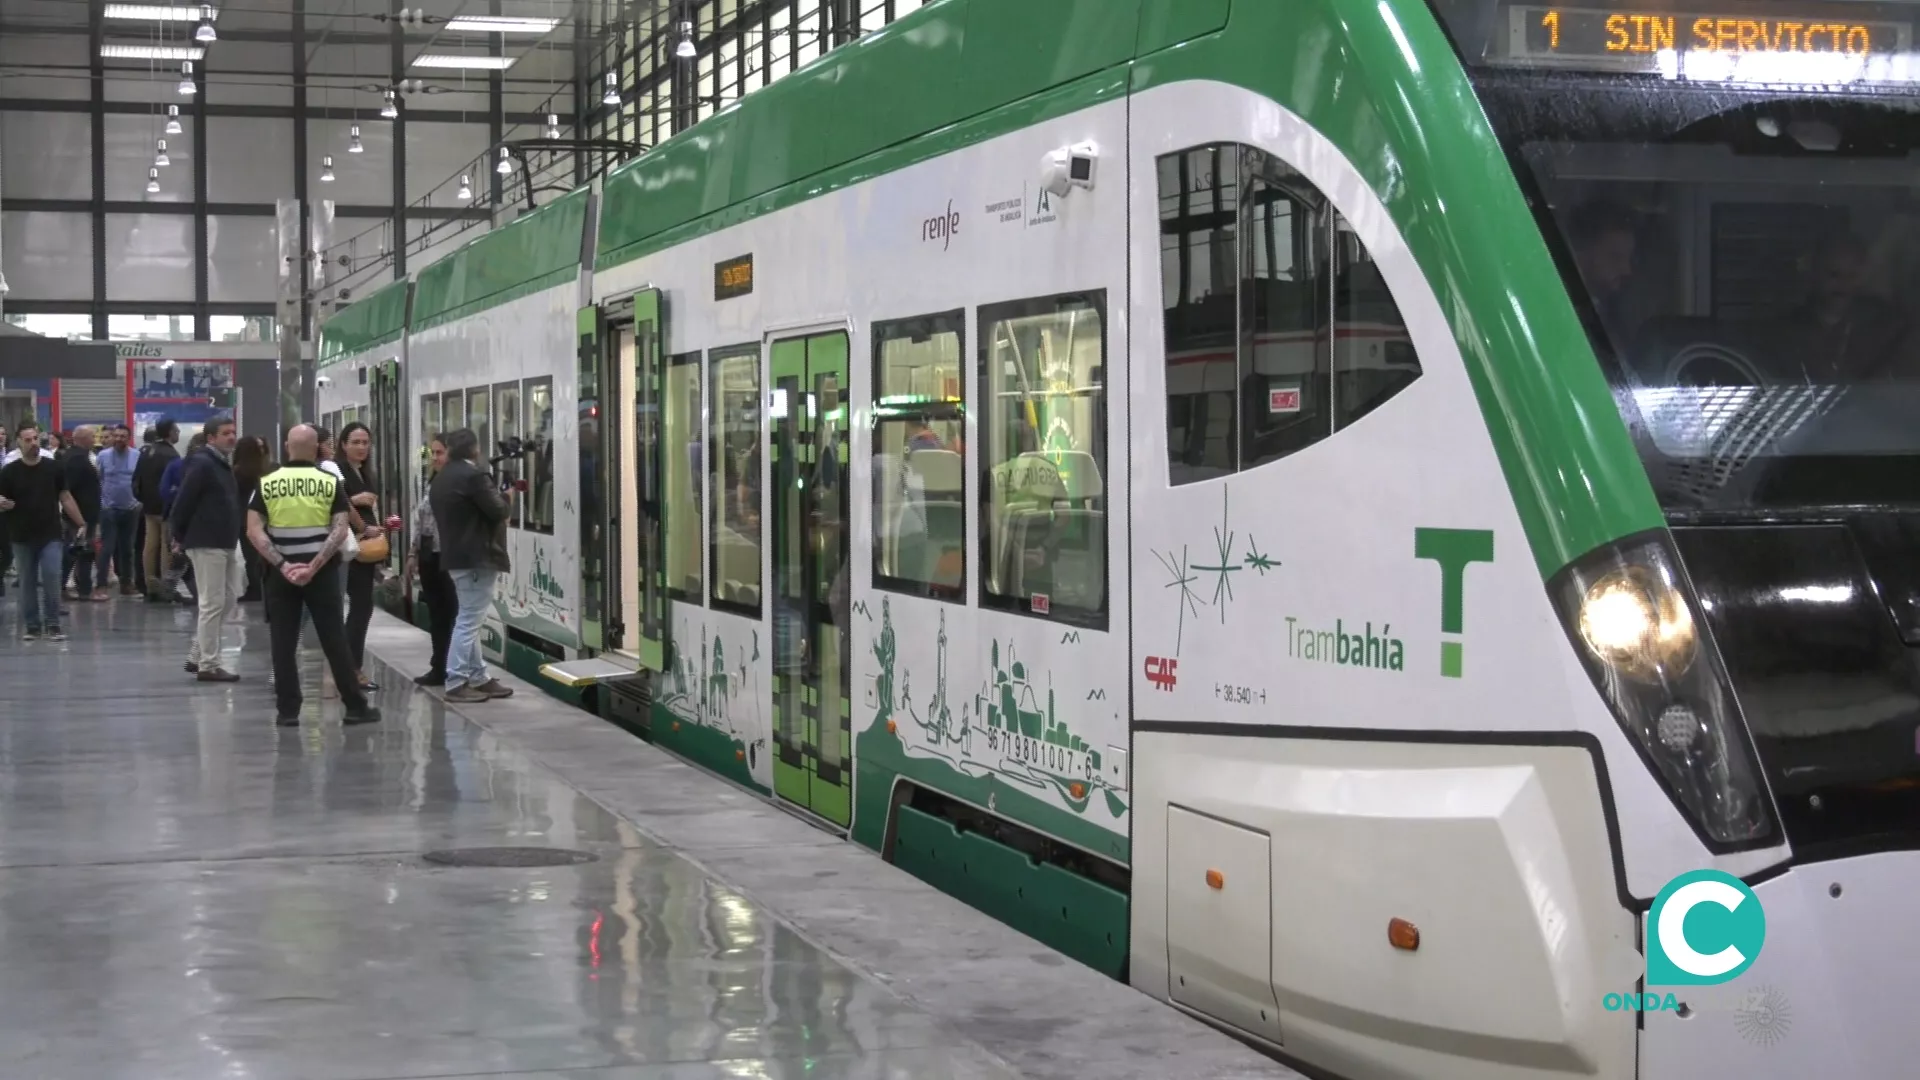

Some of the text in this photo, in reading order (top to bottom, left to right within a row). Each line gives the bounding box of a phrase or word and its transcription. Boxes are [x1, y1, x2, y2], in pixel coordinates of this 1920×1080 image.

[1541, 11, 1559, 48] 1
[1606, 14, 1675, 52] SIN
[922, 198, 960, 252] renfe
[263, 478, 334, 500] SEGURIDAD
[1285, 616, 1404, 672] Trambahía
[1144, 655, 1177, 692] CAF
[1223, 684, 1251, 705] 38.540
